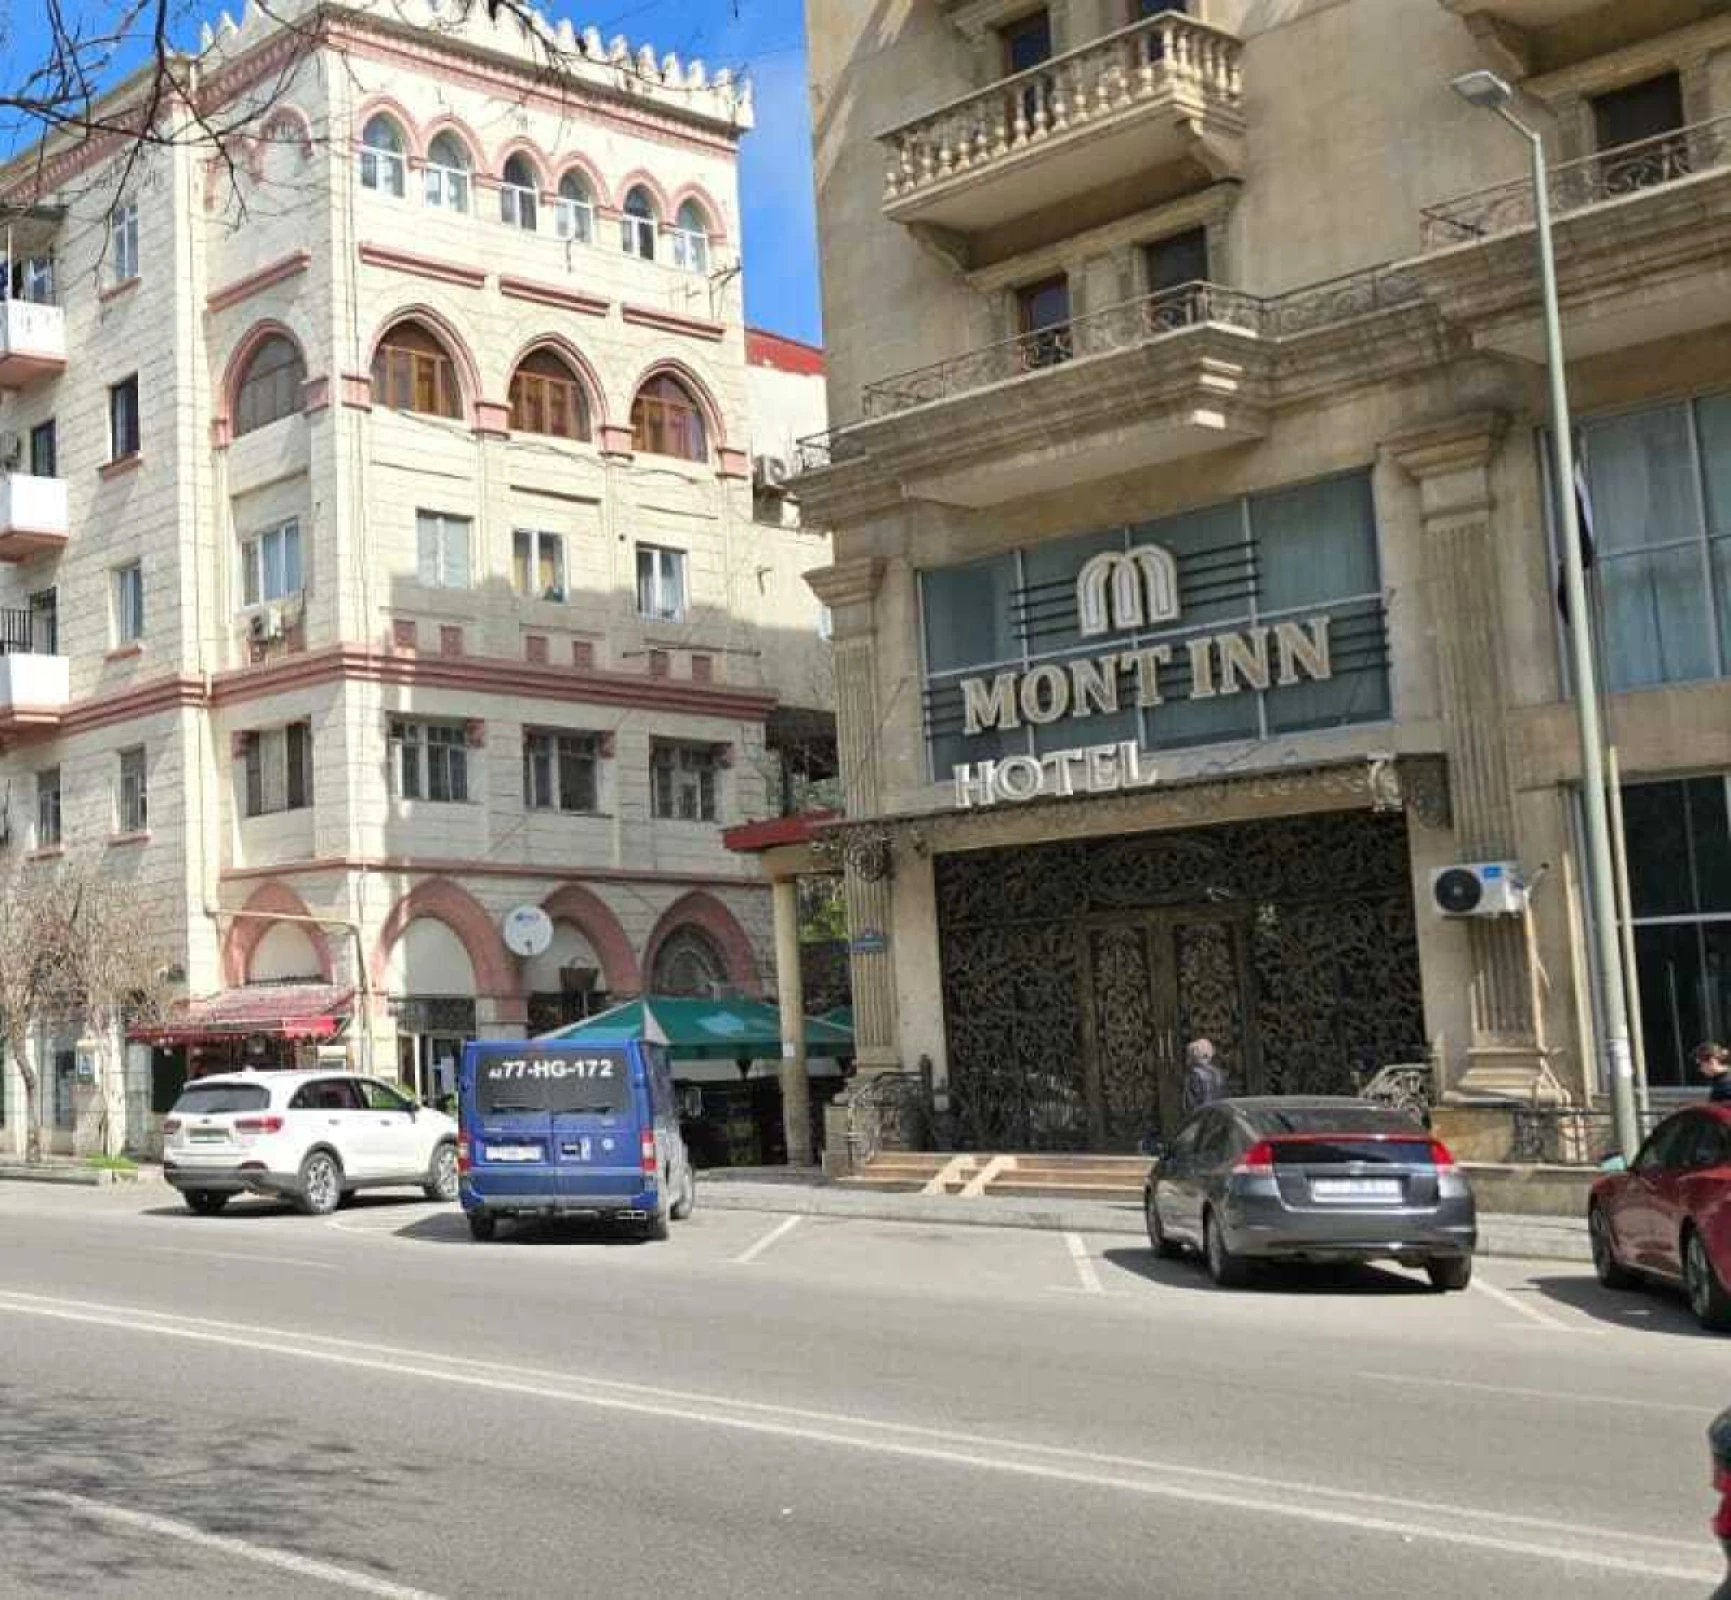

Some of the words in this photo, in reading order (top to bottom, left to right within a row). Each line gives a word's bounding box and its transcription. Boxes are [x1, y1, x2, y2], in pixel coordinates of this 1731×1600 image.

[960, 647, 1170, 735] MONT
[1187, 615, 1332, 700] INN
[952, 740, 1158, 808] HOTEL
